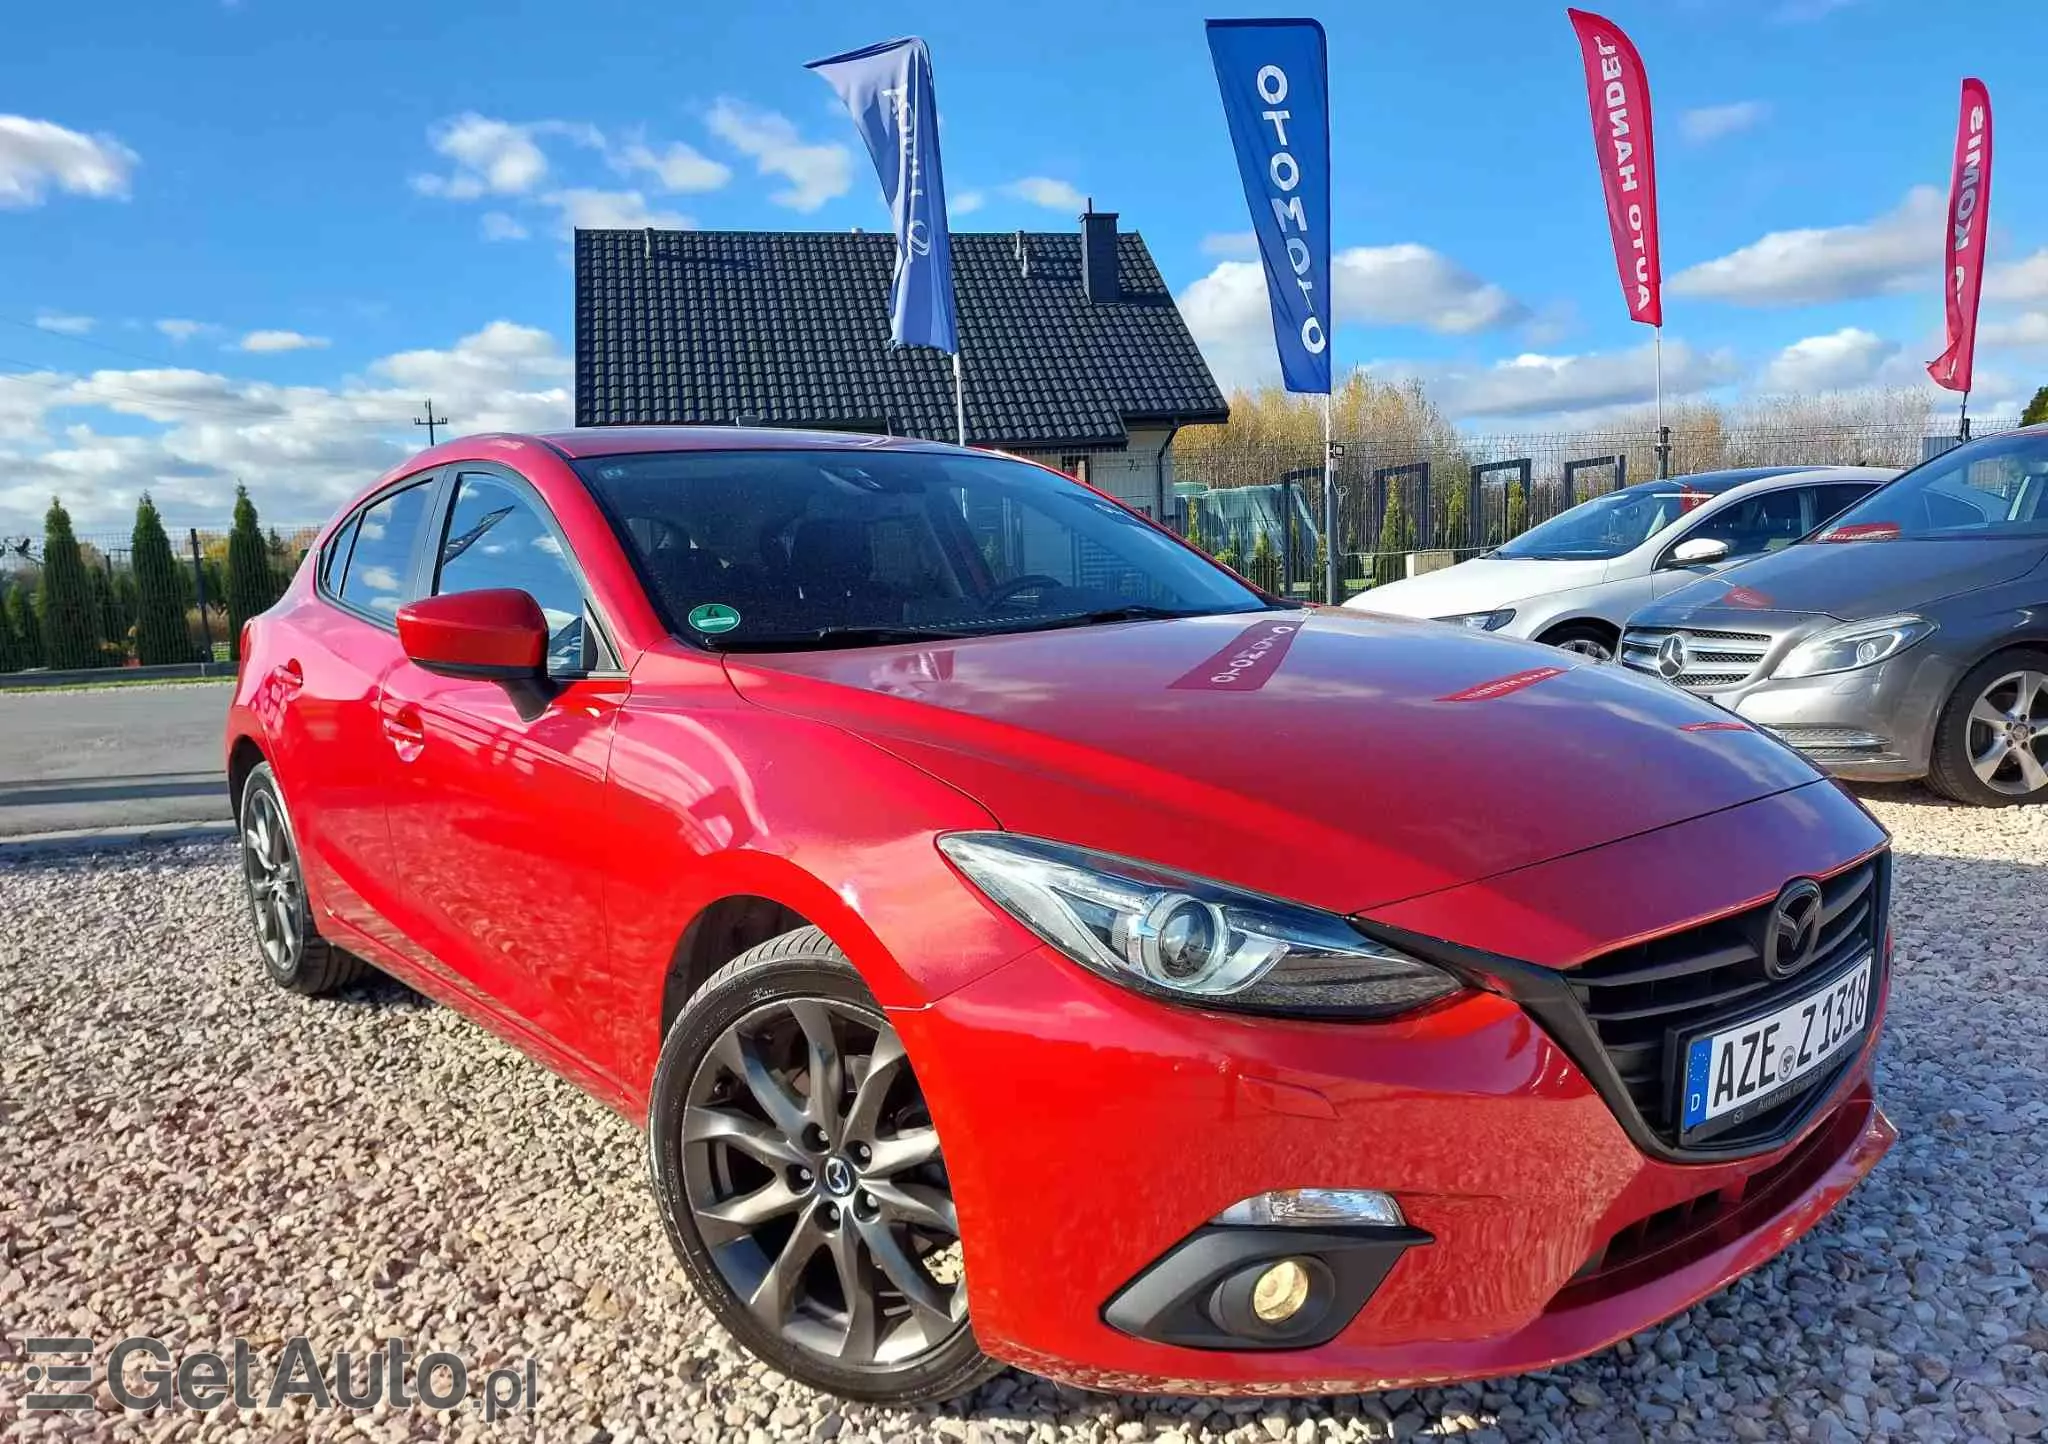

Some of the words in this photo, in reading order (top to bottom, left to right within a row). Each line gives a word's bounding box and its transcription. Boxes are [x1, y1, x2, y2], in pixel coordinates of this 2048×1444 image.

[1256, 64, 1326, 354] OTOMOTO
[1691, 1094, 1701, 1112] D
[1714, 1022, 1779, 1107] AZE
